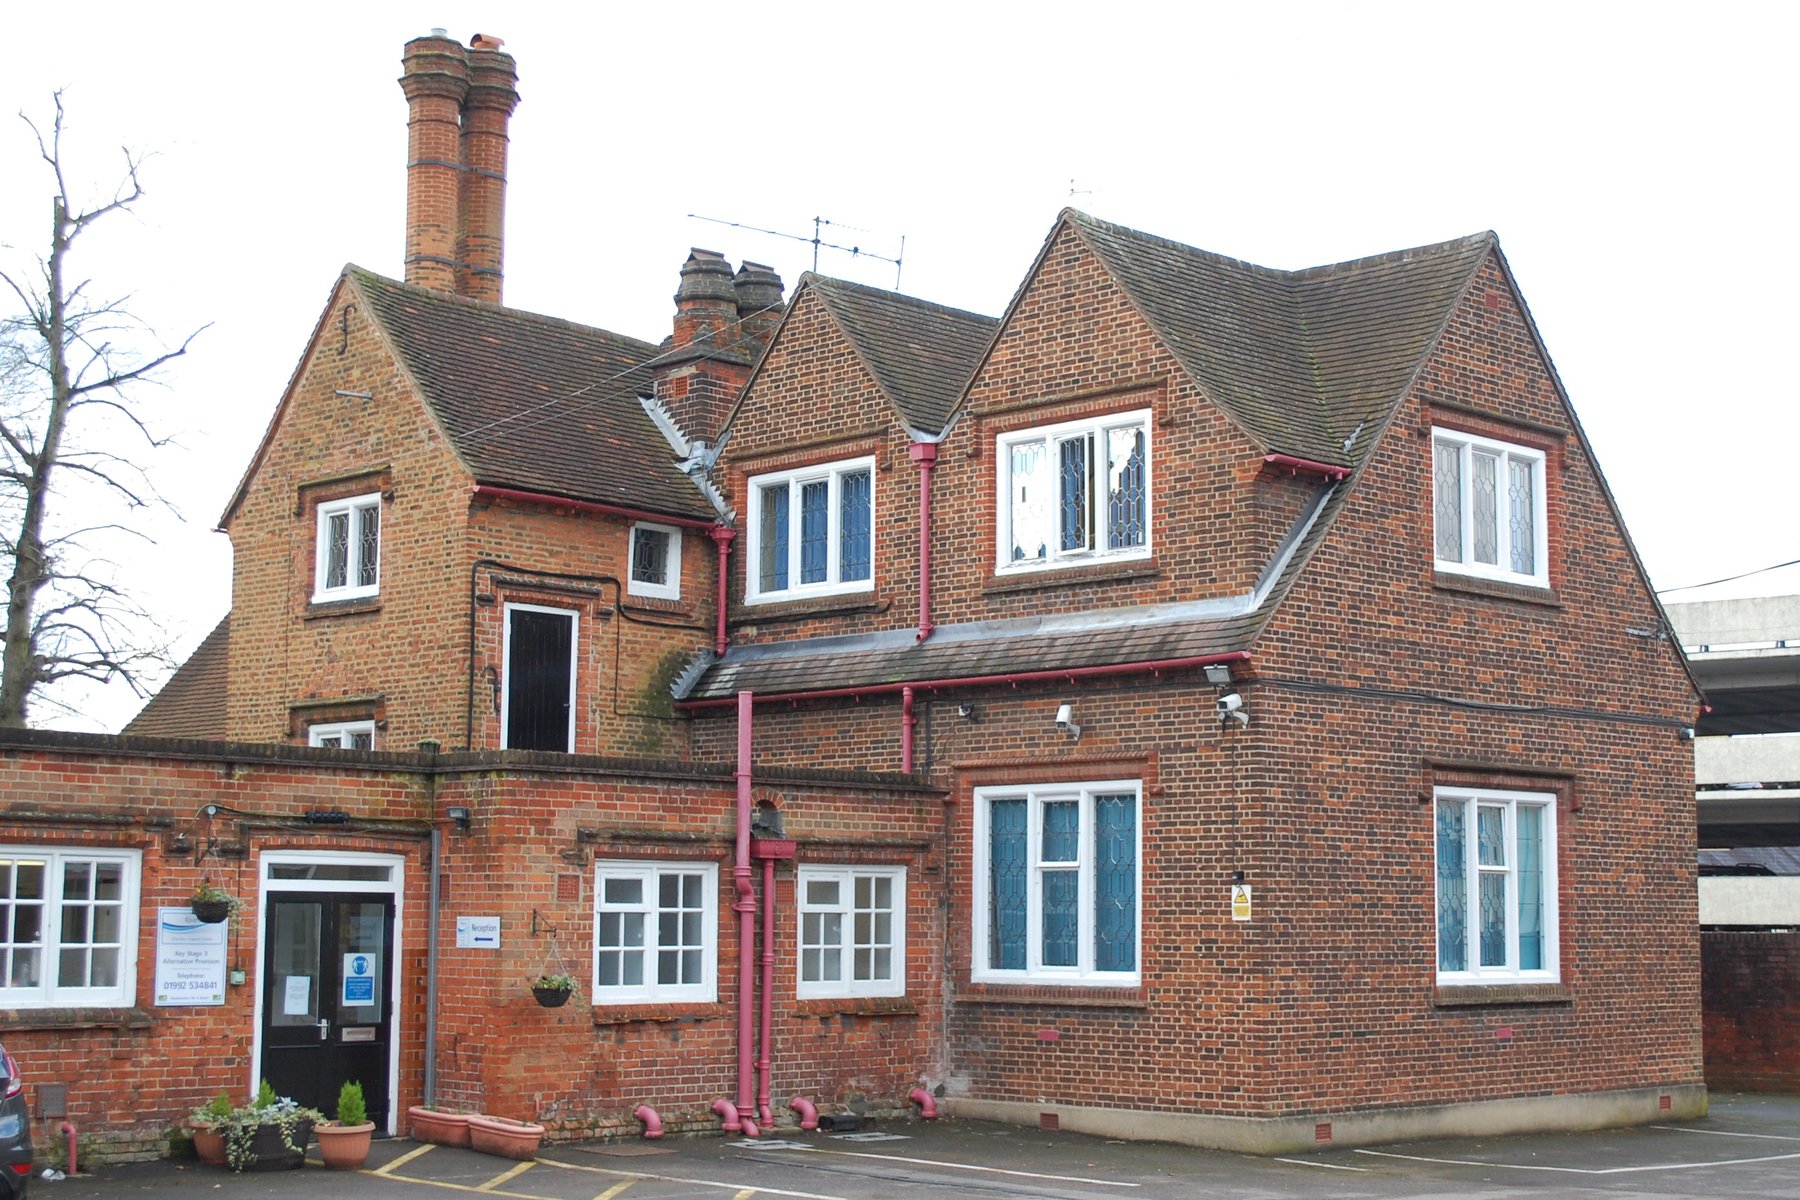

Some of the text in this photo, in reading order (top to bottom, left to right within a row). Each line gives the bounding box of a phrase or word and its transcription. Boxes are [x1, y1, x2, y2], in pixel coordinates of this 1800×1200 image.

[472, 924, 496, 932] Reception
[164, 982, 217, 990] 01992 534841
